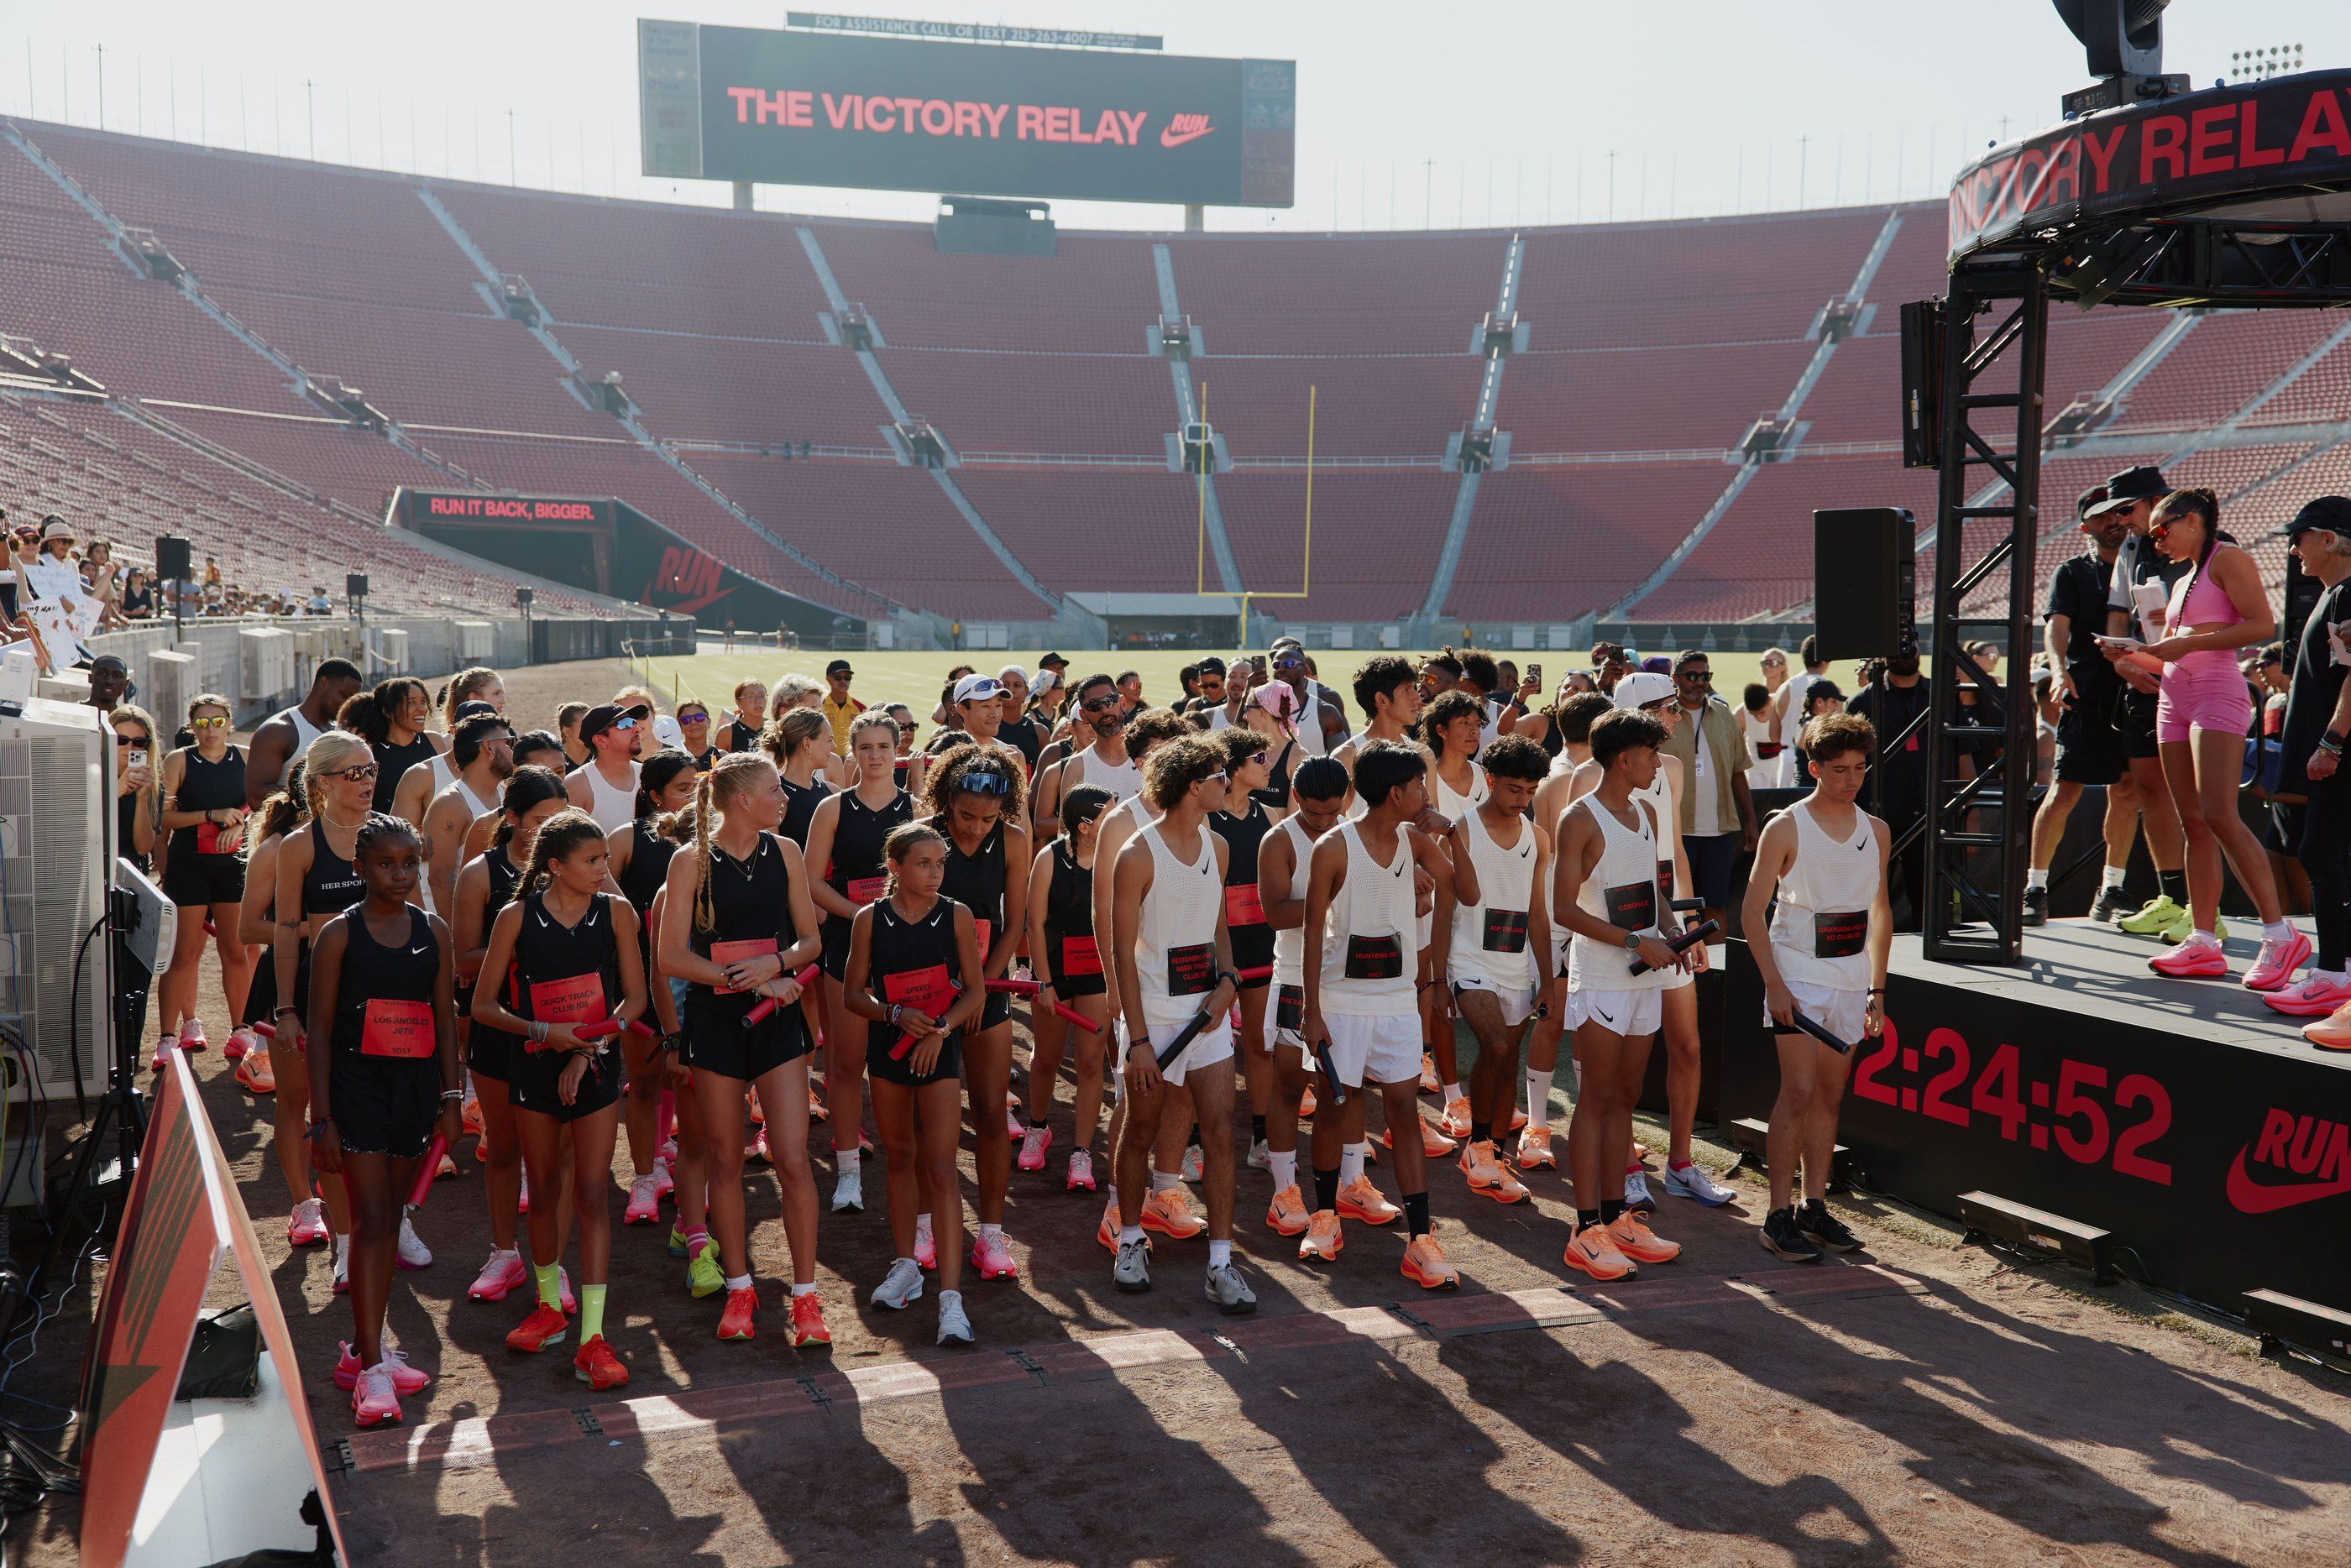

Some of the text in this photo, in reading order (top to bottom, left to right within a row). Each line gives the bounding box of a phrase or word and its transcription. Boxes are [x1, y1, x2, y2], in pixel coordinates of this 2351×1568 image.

[814, 16, 841, 29] FOR
[845, 18, 917, 34] ASSISTANCE
[920, 23, 951, 37] CALL
[955, 25, 974, 39] OR
[977, 26, 1007, 39] TEXT
[1010, 29, 1094, 45] 213-263-4007
[727, 86, 814, 128] THE
[822, 93, 1010, 138] VICTORY
[1017, 105, 1148, 145] RELAY
[1170, 112, 1210, 133] RUN
[2139, 87, 2351, 185] RELA
[431, 497, 594, 520] RUN IT BACK, BIGGER.
[655, 546, 725, 597] RUN
[341, 879, 365, 888] SPO
[859, 882, 886, 891] REDON
[1171, 954, 1202, 964] REDONDO
[540, 989, 597, 1006] QUICK TRACK
[552, 1001, 589, 1014] CLUB (G)
[392, 1027, 414, 1035] JETS
[394, 1017, 430, 1026] ANGELES
[1846, 1012, 2172, 1186] 2:24:52
